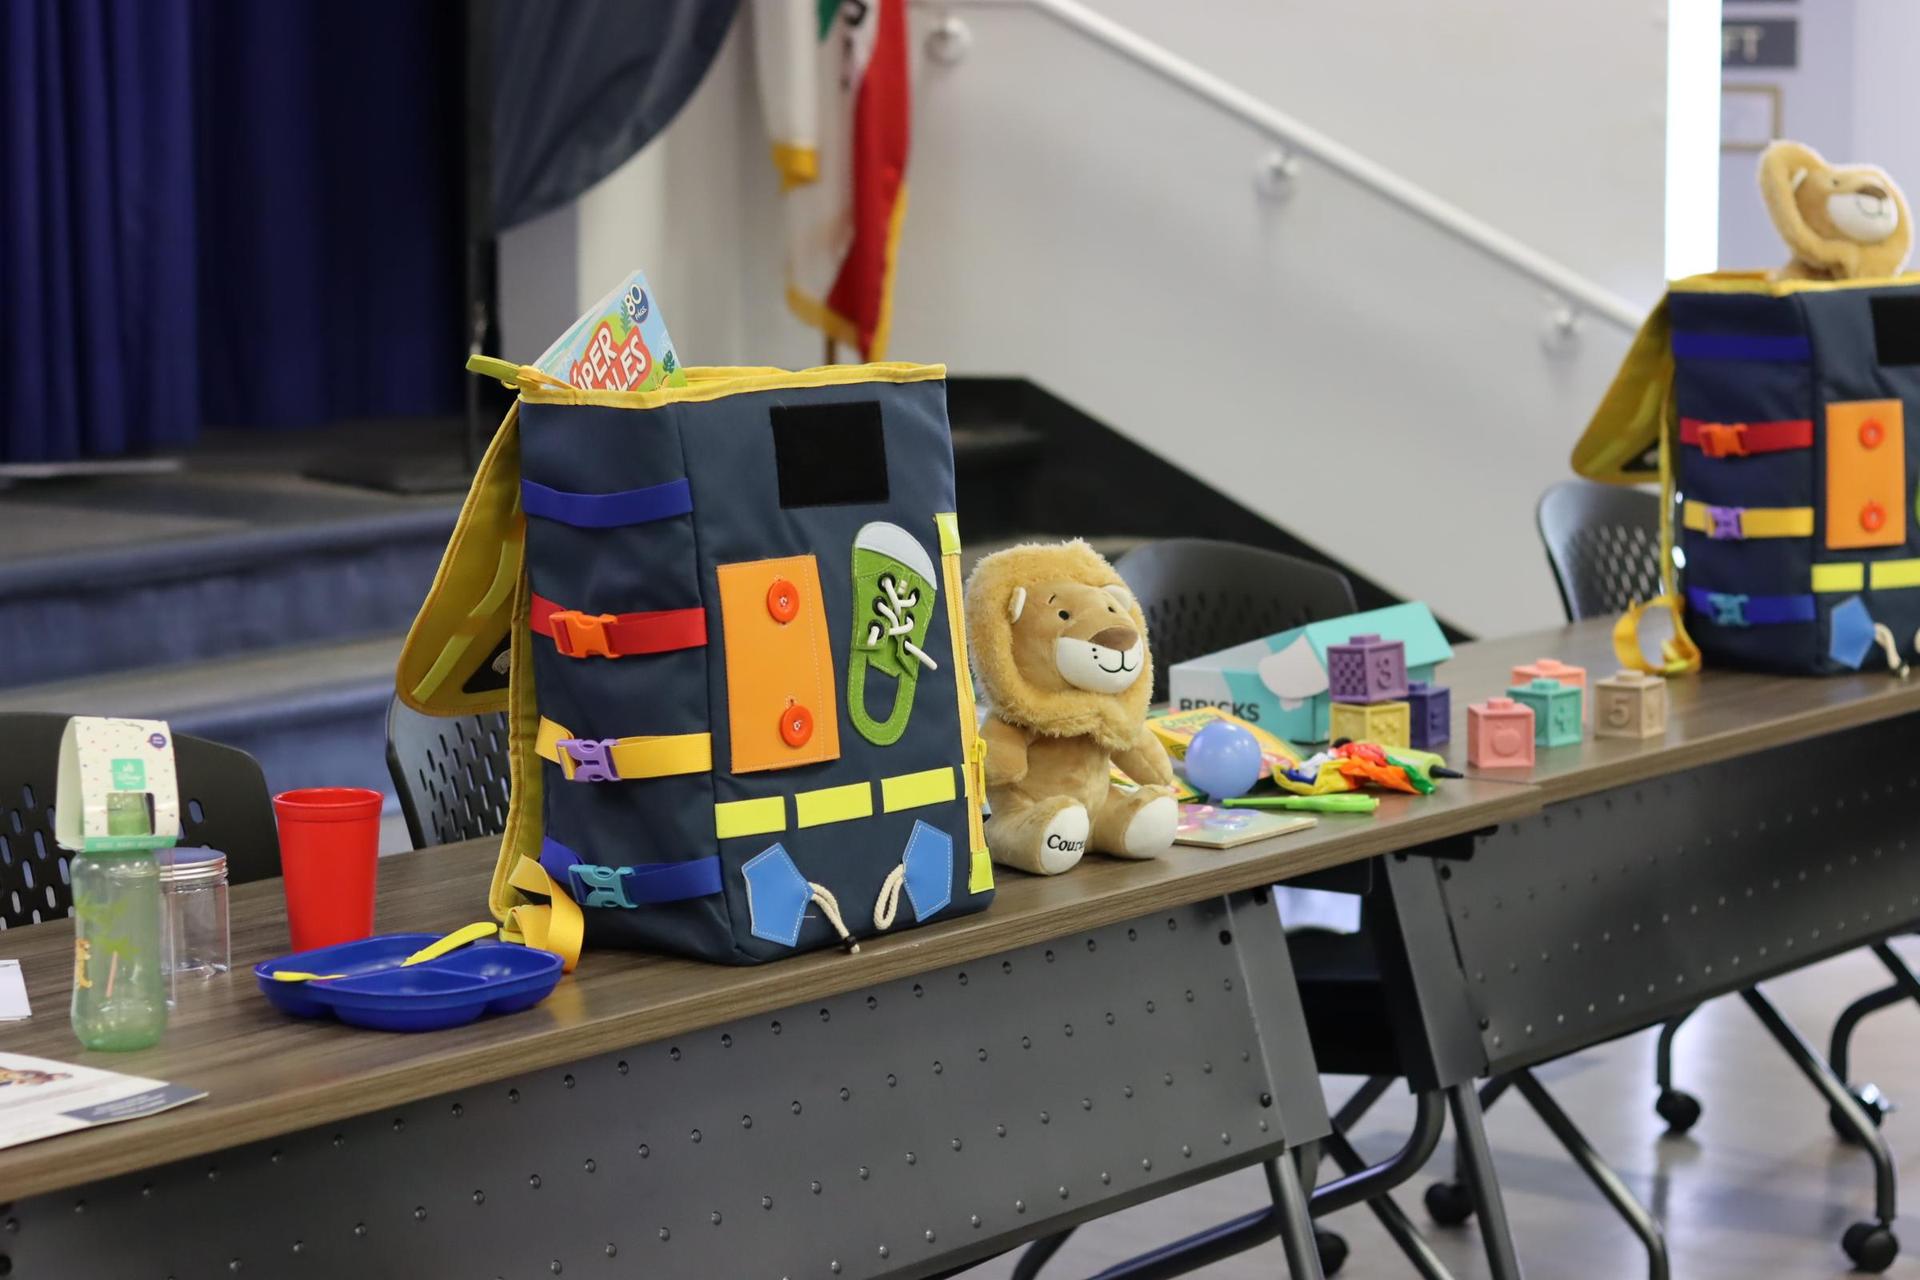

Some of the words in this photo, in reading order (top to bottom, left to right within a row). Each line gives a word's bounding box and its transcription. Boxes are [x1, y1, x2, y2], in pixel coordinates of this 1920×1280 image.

[624, 284, 642, 316] 80
[1179, 698, 1260, 722] BKS
[1608, 693, 1630, 728] 5
